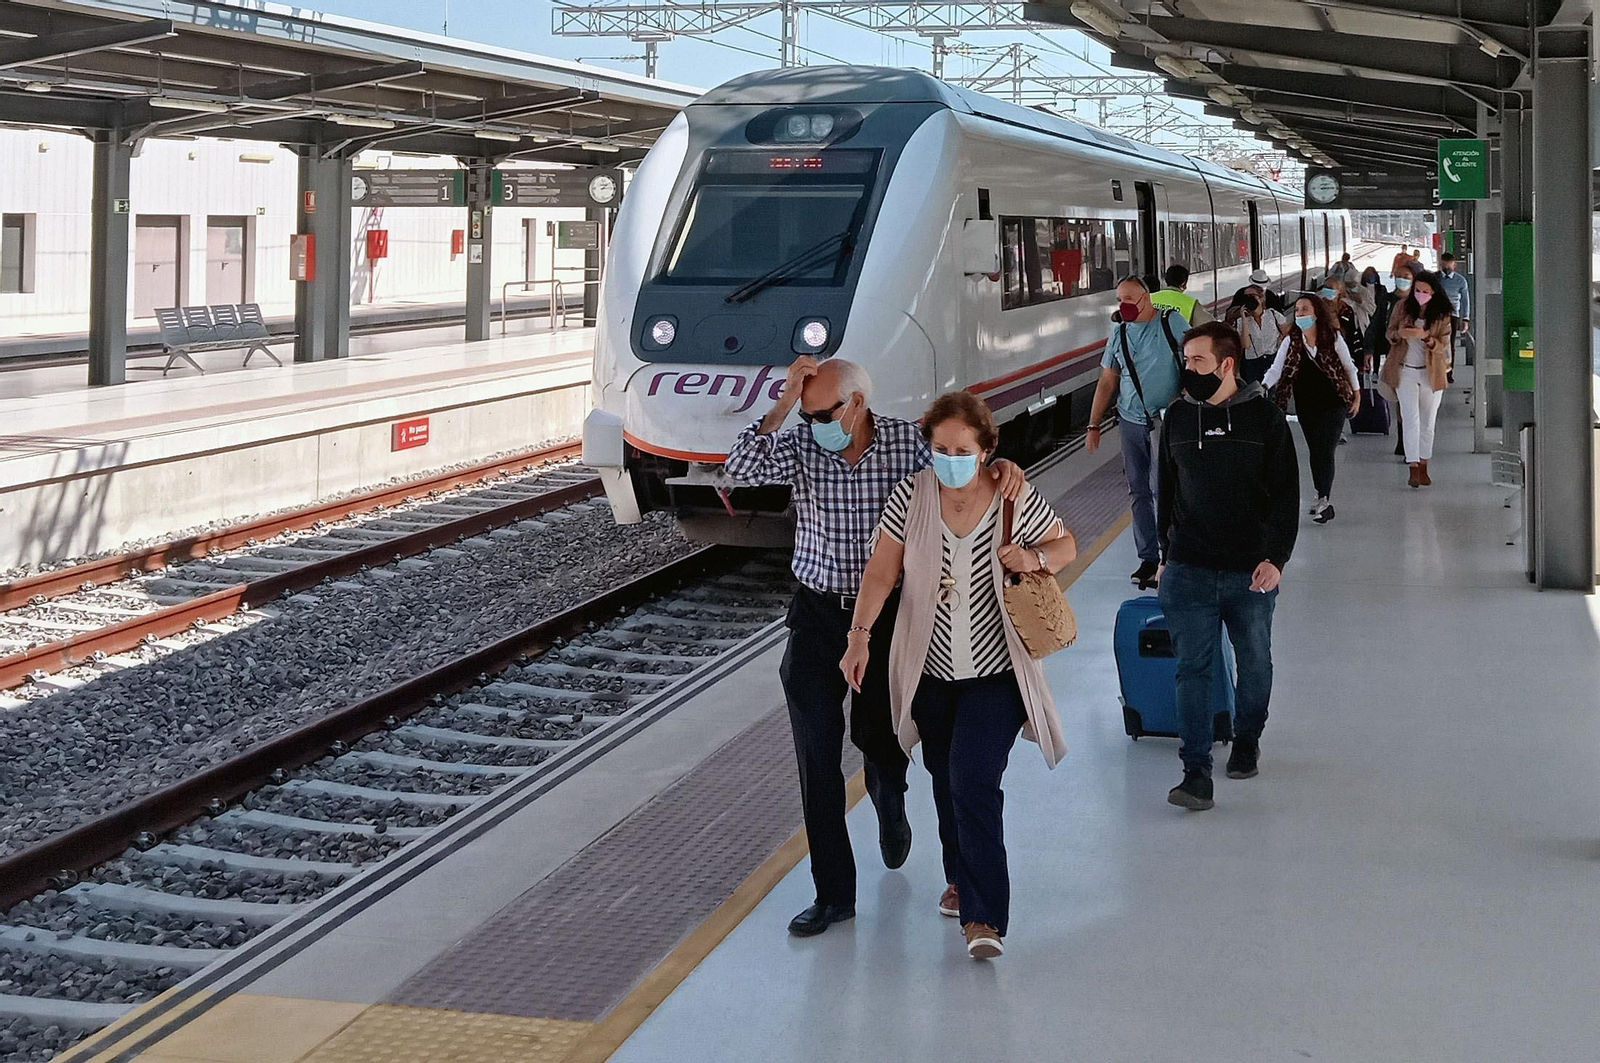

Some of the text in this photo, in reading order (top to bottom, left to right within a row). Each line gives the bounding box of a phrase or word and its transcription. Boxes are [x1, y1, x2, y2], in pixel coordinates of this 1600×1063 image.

[441, 185, 450, 201] 1
[504, 184, 514, 201] 3
[1432, 188, 1443, 206] 5
